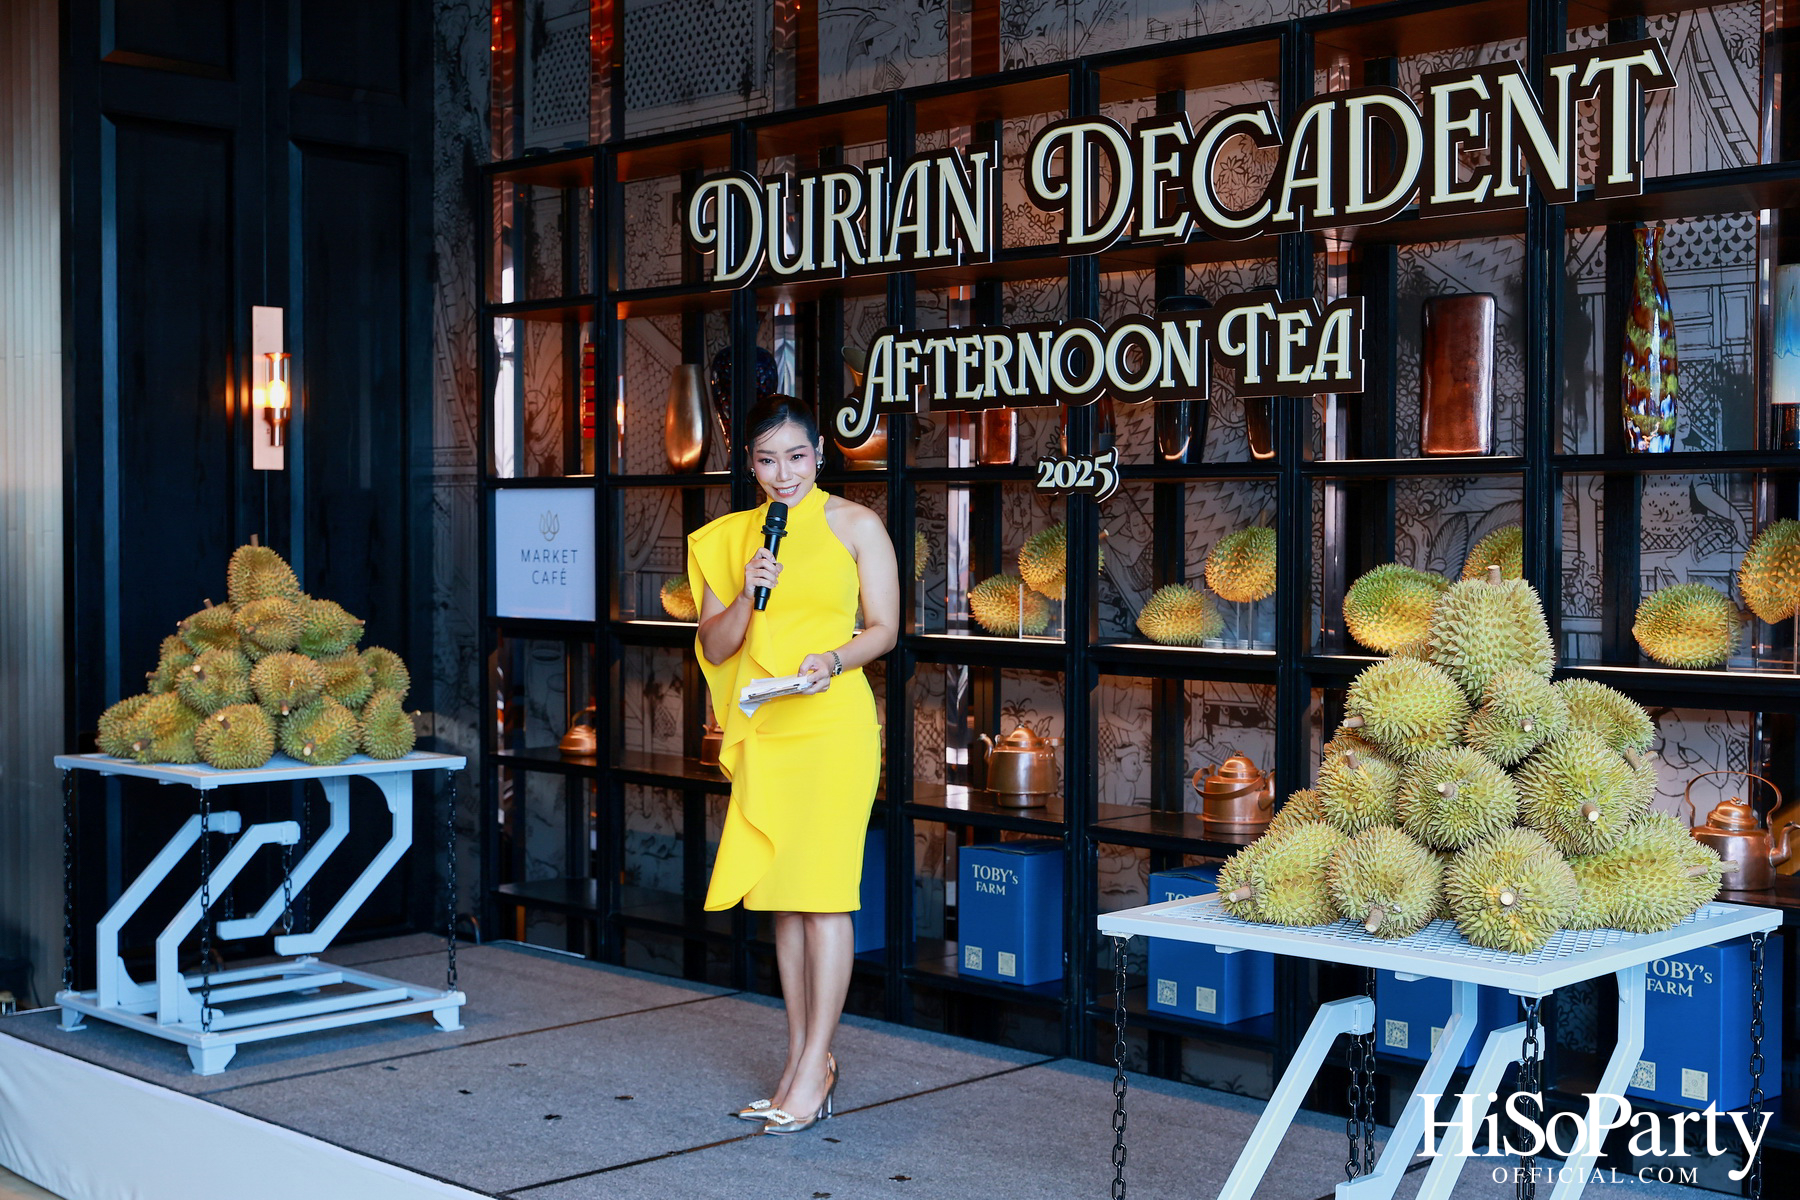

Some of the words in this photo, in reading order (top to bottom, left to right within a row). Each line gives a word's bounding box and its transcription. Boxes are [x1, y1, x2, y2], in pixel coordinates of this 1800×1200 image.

[688, 150, 989, 283] DURIAN
[1031, 48, 1663, 245] DECADENT
[836, 319, 1202, 439] AFTERNOON
[1218, 303, 1353, 385] TEA
[1037, 452, 1114, 497] 2025
[521, 549, 578, 564] MARKET
[532, 568, 567, 586] CAFÉ
[972, 864, 1018, 885] TOBY's
[976, 881, 1006, 896] FARM
[1646, 978, 1693, 998] FARM
